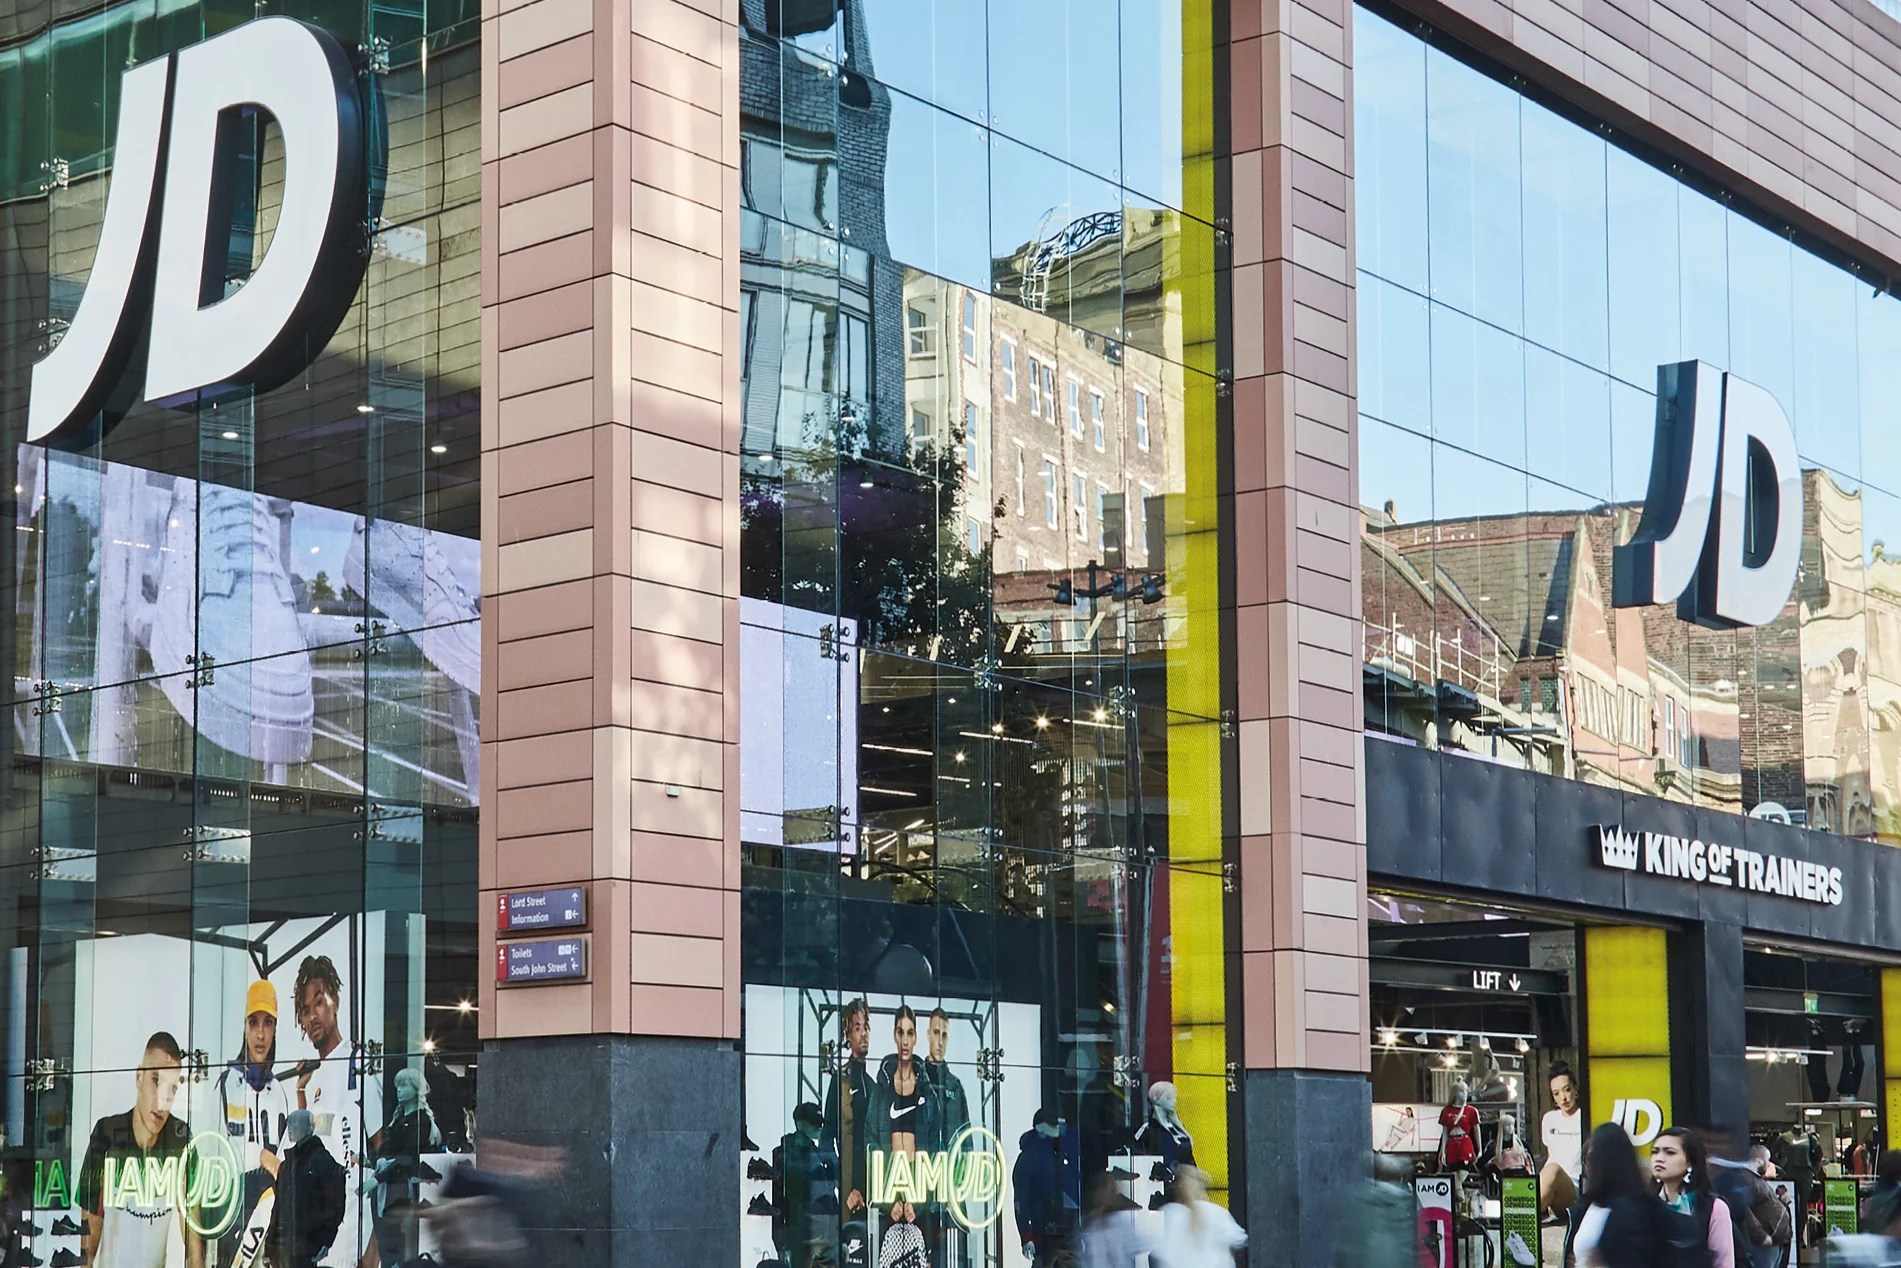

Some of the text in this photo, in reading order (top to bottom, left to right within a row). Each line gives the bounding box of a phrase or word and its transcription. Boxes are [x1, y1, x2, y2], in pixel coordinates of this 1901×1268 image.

[27, 15, 340, 442] JD
[1651, 360, 1804, 628] JD
[1644, 832, 1843, 906] KING OF TRAINERS
[511, 896, 546, 908] Lord Street
[511, 911, 549, 924] Information
[511, 948, 532, 959] Toilets
[511, 962, 568, 977] South John Street
[1472, 969, 1502, 991] LIFT
